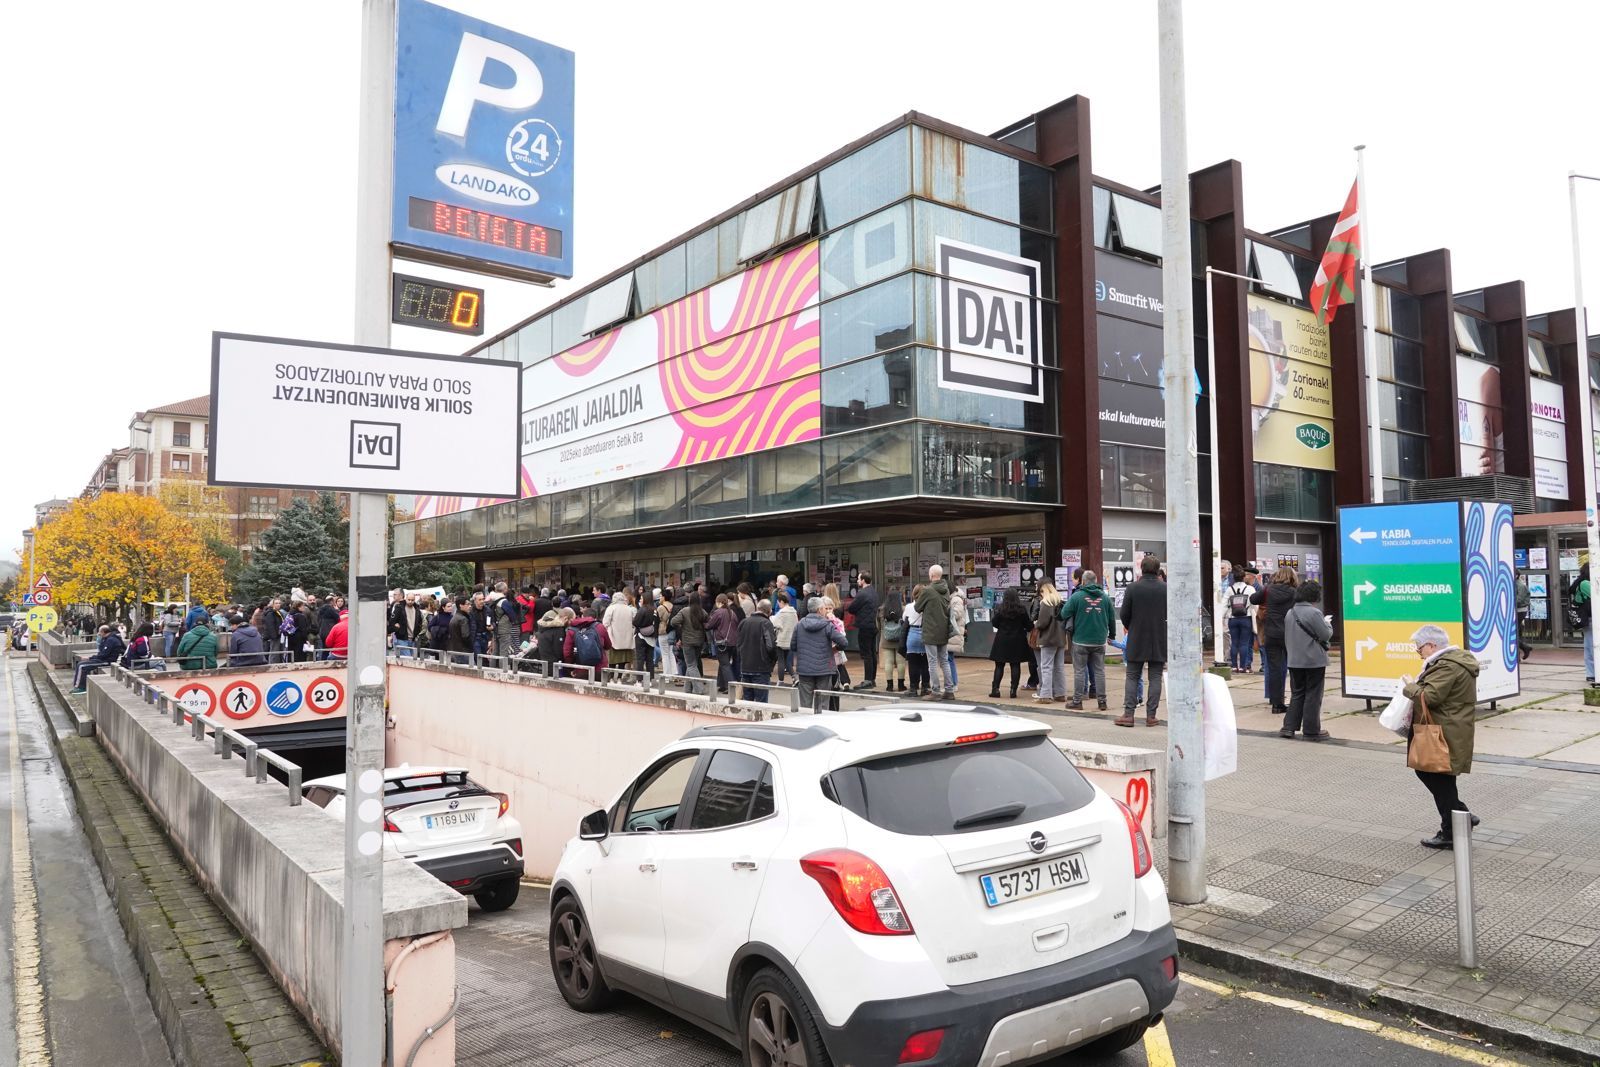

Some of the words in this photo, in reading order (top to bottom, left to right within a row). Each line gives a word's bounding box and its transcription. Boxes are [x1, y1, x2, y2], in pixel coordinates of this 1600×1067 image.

[435, 31, 544, 138] P
[511, 125, 550, 161] 24
[450, 170, 532, 202] LANDAKO
[433, 202, 548, 255] BETETA
[1109, 287, 1148, 309] Smurfit
[957, 288, 1024, 355] DA!
[1313, 348, 1328, 361] dute
[275, 363, 385, 387] AUTORIZADOS
[389, 374, 428, 391] PARA
[1292, 370, 1329, 390] Zorionak!
[433, 378, 471, 395] SOLO
[273, 385, 420, 411] BAIMENDUENTZAT
[425, 397, 473, 415] SOILIK
[583, 383, 643, 427] JAIALDIA
[357, 434, 393, 456] DA!
[1381, 529, 1411, 539] KABIA
[1383, 584, 1453, 594] SAGUGANBARA
[314, 688, 337, 702] 20
[434, 816, 457, 827] 1169
[460, 812, 476, 824] LNV
[998, 867, 1041, 898] 5737
[1048, 858, 1083, 886] HSM
